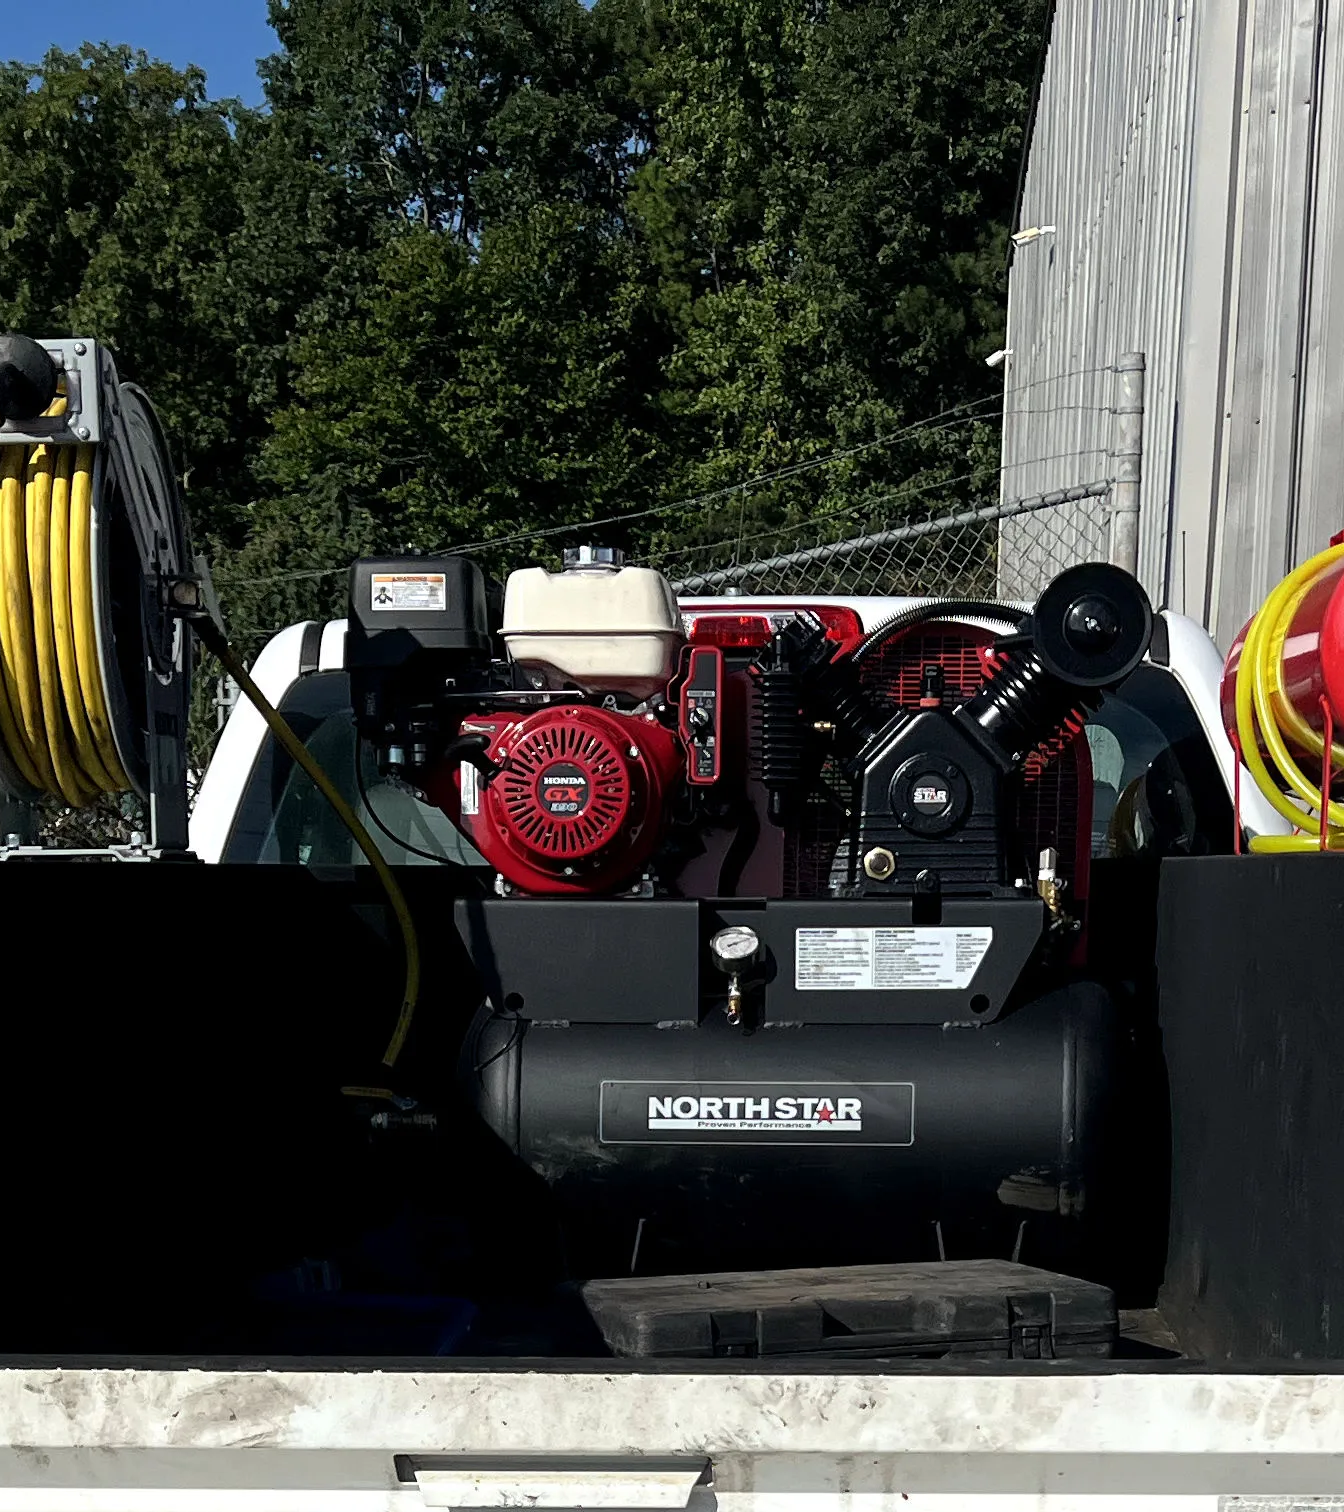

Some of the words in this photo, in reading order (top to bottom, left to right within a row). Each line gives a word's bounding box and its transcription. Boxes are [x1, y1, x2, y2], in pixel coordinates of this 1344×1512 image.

[543, 777, 586, 785] HONDA
[544, 787, 584, 802] GX
[913, 790, 947, 801] STAR
[648, 1096, 770, 1119] NORTH
[774, 1097, 862, 1121] STAR
[697, 1121, 737, 1129] Proven
[739, 1121, 813, 1129] Performance
